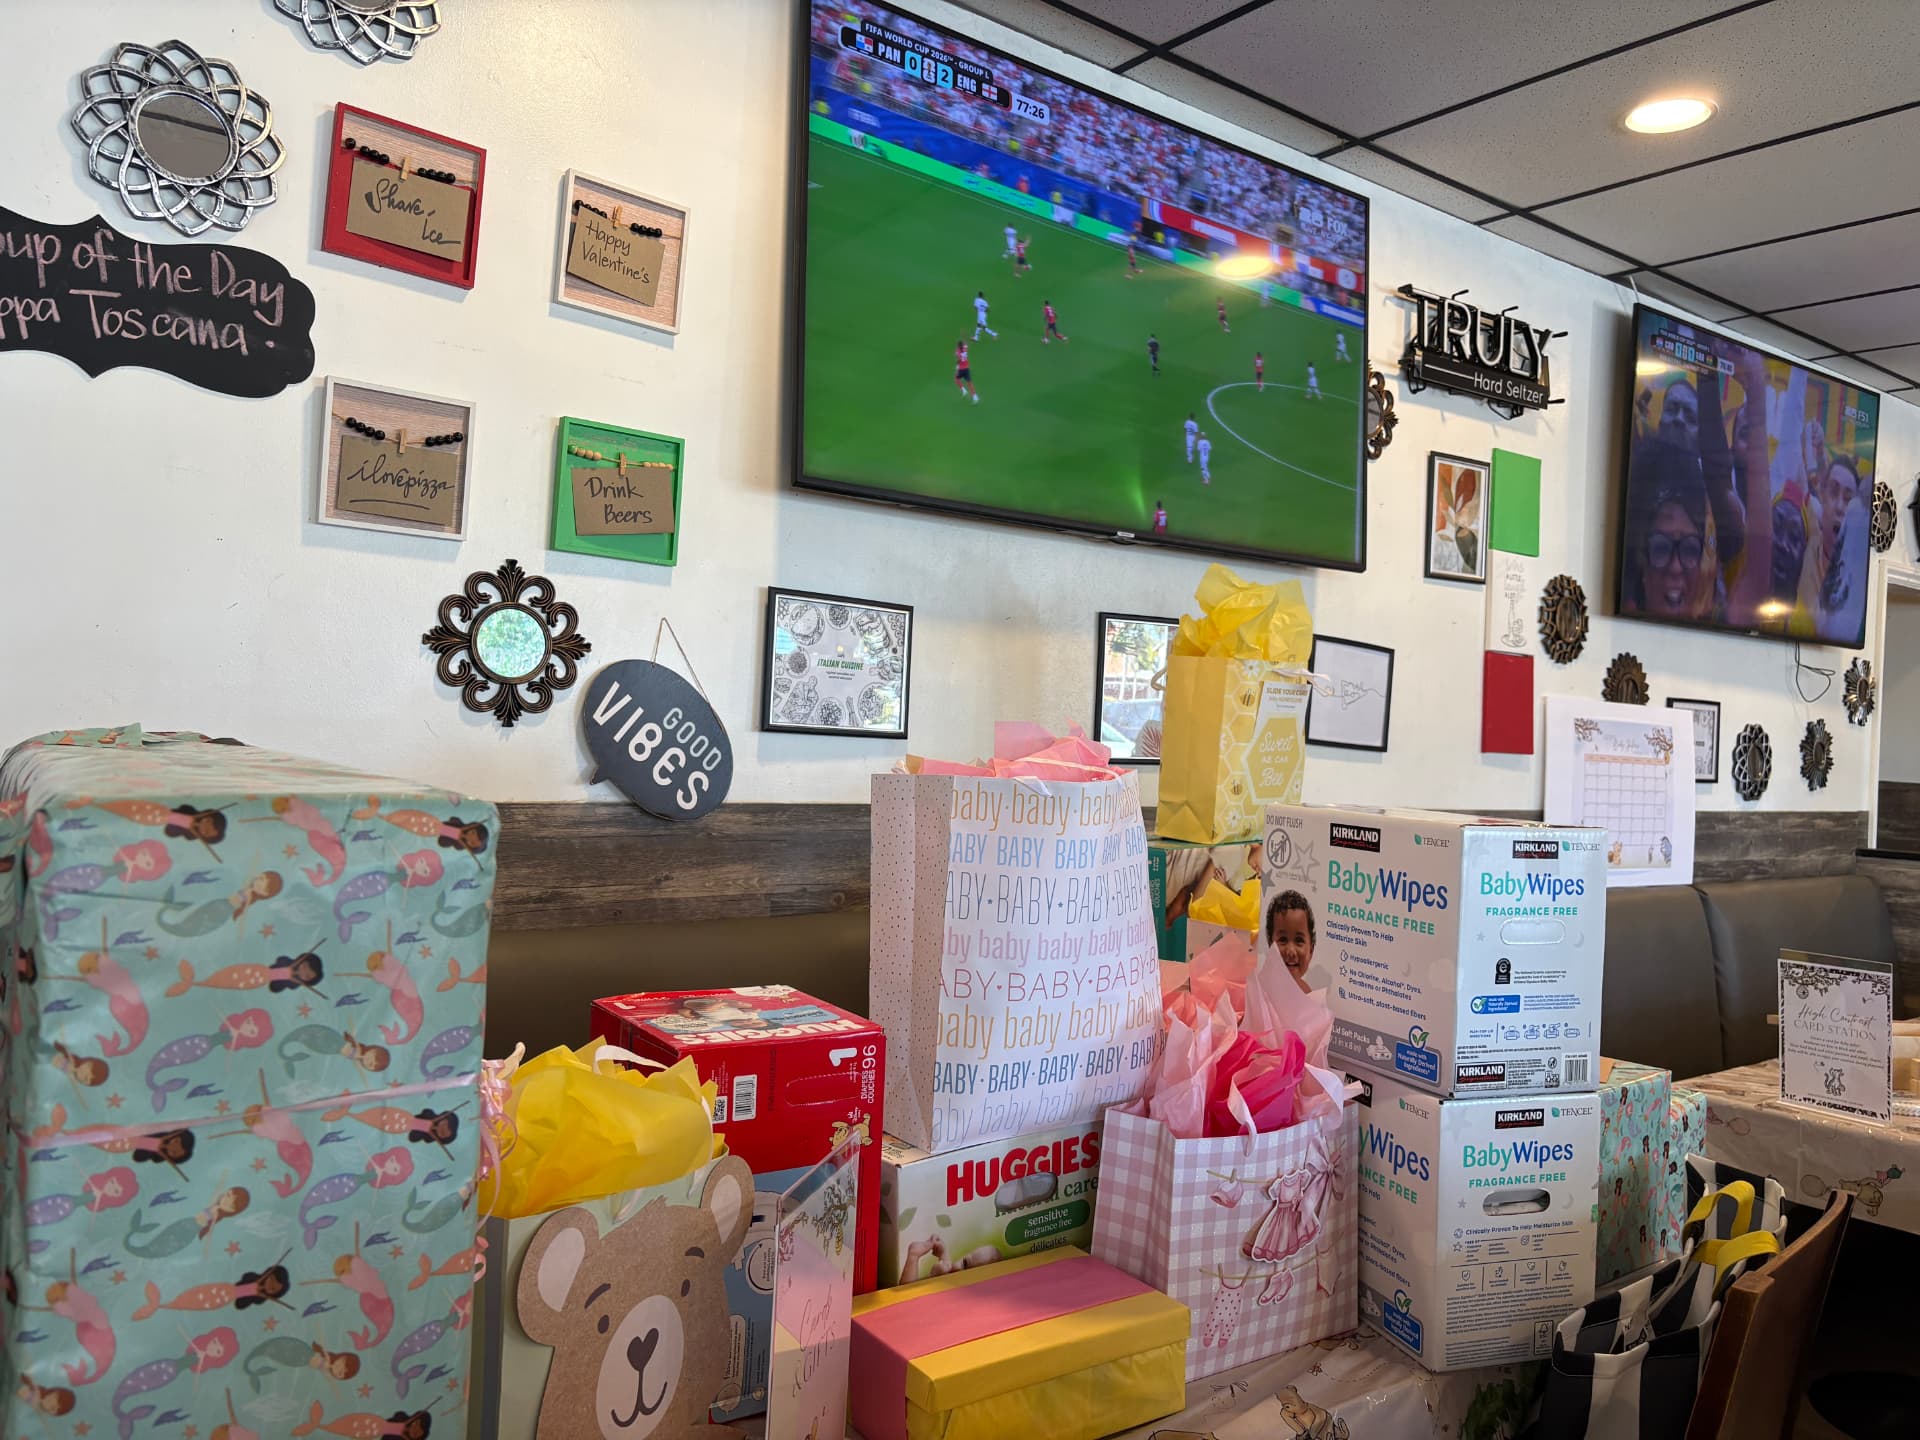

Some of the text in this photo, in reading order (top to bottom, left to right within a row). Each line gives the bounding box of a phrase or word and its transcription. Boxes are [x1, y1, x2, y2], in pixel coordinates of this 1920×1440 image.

[865, 23, 883, 37] FIFA
[884, 29, 913, 49] WORLD
[914, 43, 930, 55] CUP
[958, 60, 985, 77] GROUP
[985, 70, 990, 79] L
[878, 42, 977, 93] PAN 0 2 ENG
[1016, 99, 1045, 119] 77:26
[586, 220, 631, 256] Happy
[0, 228, 285, 327] up of the Day
[583, 241, 650, 284] Valentine's
[1398, 285, 1552, 380] TRULY
[1473, 371, 1544, 405] Hard Seltzer
[583, 476, 645, 499] Drink
[603, 503, 653, 525] Beers
[592, 681, 710, 811] VIBES
[663, 707, 722, 771] GOOD
[1079, 787, 1117, 832] baby
[1266, 814, 1304, 830] DO NOT FLUSH
[950, 832, 988, 865] ABY
[997, 835, 1045, 869] BABY
[1055, 838, 1098, 869] BABY
[1332, 826, 1380, 843] KIRKLAND
[1514, 841, 1559, 853] KIRKLAND
[945, 870, 986, 921] ABY
[996, 874, 1056, 925] BABY
[1066, 874, 1110, 925] BABY
[1327, 859, 1449, 913] BabyWipes
[1480, 871, 1585, 903] BabyWipes
[1327, 902, 1436, 935] FRAGRANCE FREE
[1485, 906, 1578, 916] FRAGRANCE FREE
[947, 926, 972, 964] by
[978, 928, 1031, 969] baby
[1037, 931, 1083, 965] baby
[1087, 926, 1123, 958] baby
[1326, 920, 1395, 944] Clinically Proven To Help
[1007, 967, 1090, 1002] BABY
[673, 1018, 866, 1046] HUGGIES
[1003, 1004, 1062, 1054] baby
[1067, 995, 1120, 1045] baby
[1793, 1019, 1877, 1041] CARD STATION
[828, 1047, 858, 1067] 1
[862, 1044, 877, 1069] 96
[933, 1061, 979, 1095] BABY
[987, 1060, 1032, 1094] BABY
[1038, 1052, 1080, 1086] BABY
[1085, 1044, 1125, 1078] BABY
[1458, 1065, 1505, 1077] KIRKLAND
[860, 1070, 869, 1101] DIAPERS
[867, 1069, 877, 1104] COUCHES
[978, 1093, 1032, 1137] baby
[1497, 1110, 1543, 1123] KIRKLAND
[946, 1132, 1101, 1207] HUGGIES
[1463, 1140, 1574, 1173] BabyWipes
[1063, 1176, 1099, 1199] care
[1388, 1179, 1418, 1205] FREE
[1468, 1171, 1567, 1189] FRAGRANCE FREE
[1024, 1217, 1073, 1239] fragrance free
[1027, 1207, 1070, 1228] sensitive
[1465, 1226, 1491, 1236] Clinically
[1491, 1225, 1512, 1235] Proven
[1511, 1224, 1520, 1232] To
